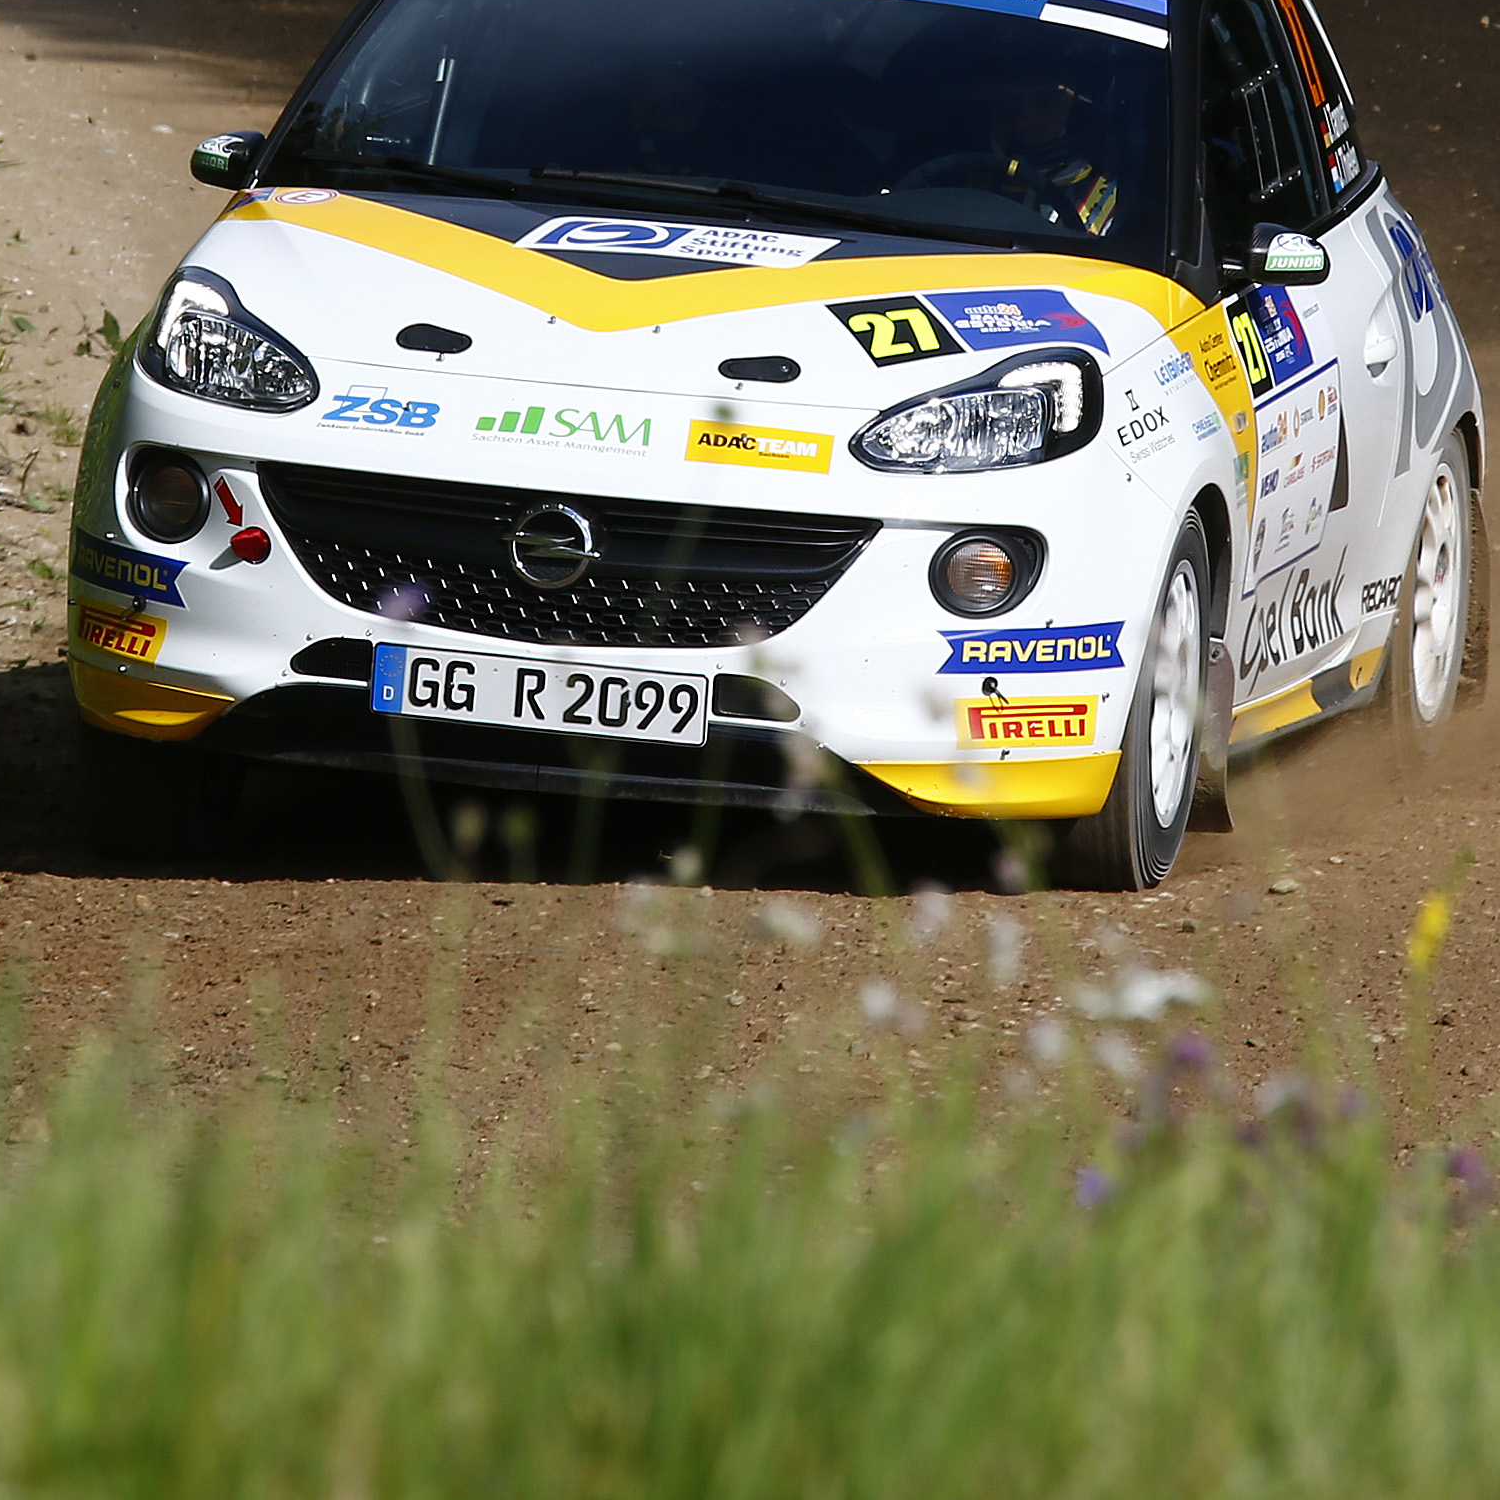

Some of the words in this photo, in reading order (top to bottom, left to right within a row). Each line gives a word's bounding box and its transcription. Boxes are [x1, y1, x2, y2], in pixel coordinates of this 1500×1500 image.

[678, 244, 757, 261] Sport
[702, 229, 780, 243] ADAC
[1269, 256, 1322, 269] JUNIOR
[848, 308, 941, 359] 27
[969, 314, 1024, 324] RALLY
[1232, 311, 1267, 385] 27
[321, 395, 441, 429] ZSB
[549, 408, 651, 446] SAM
[1117, 405, 1170, 447] EDOX
[471, 433, 523, 444] Sachsen
[526, 438, 560, 447] Asset
[563, 441, 647, 458] Management
[80, 544, 168, 591] RAVENOL
[1291, 543, 1348, 656] Bank
[79, 603, 157, 657] PIRELLI
[962, 635, 1112, 663] RAVENOL
[382, 686, 395, 701] D
[408, 657, 476, 713] GG
[513, 667, 547, 720] R
[562, 673, 700, 734] 2099
[967, 704, 1088, 740] PIRELLI
